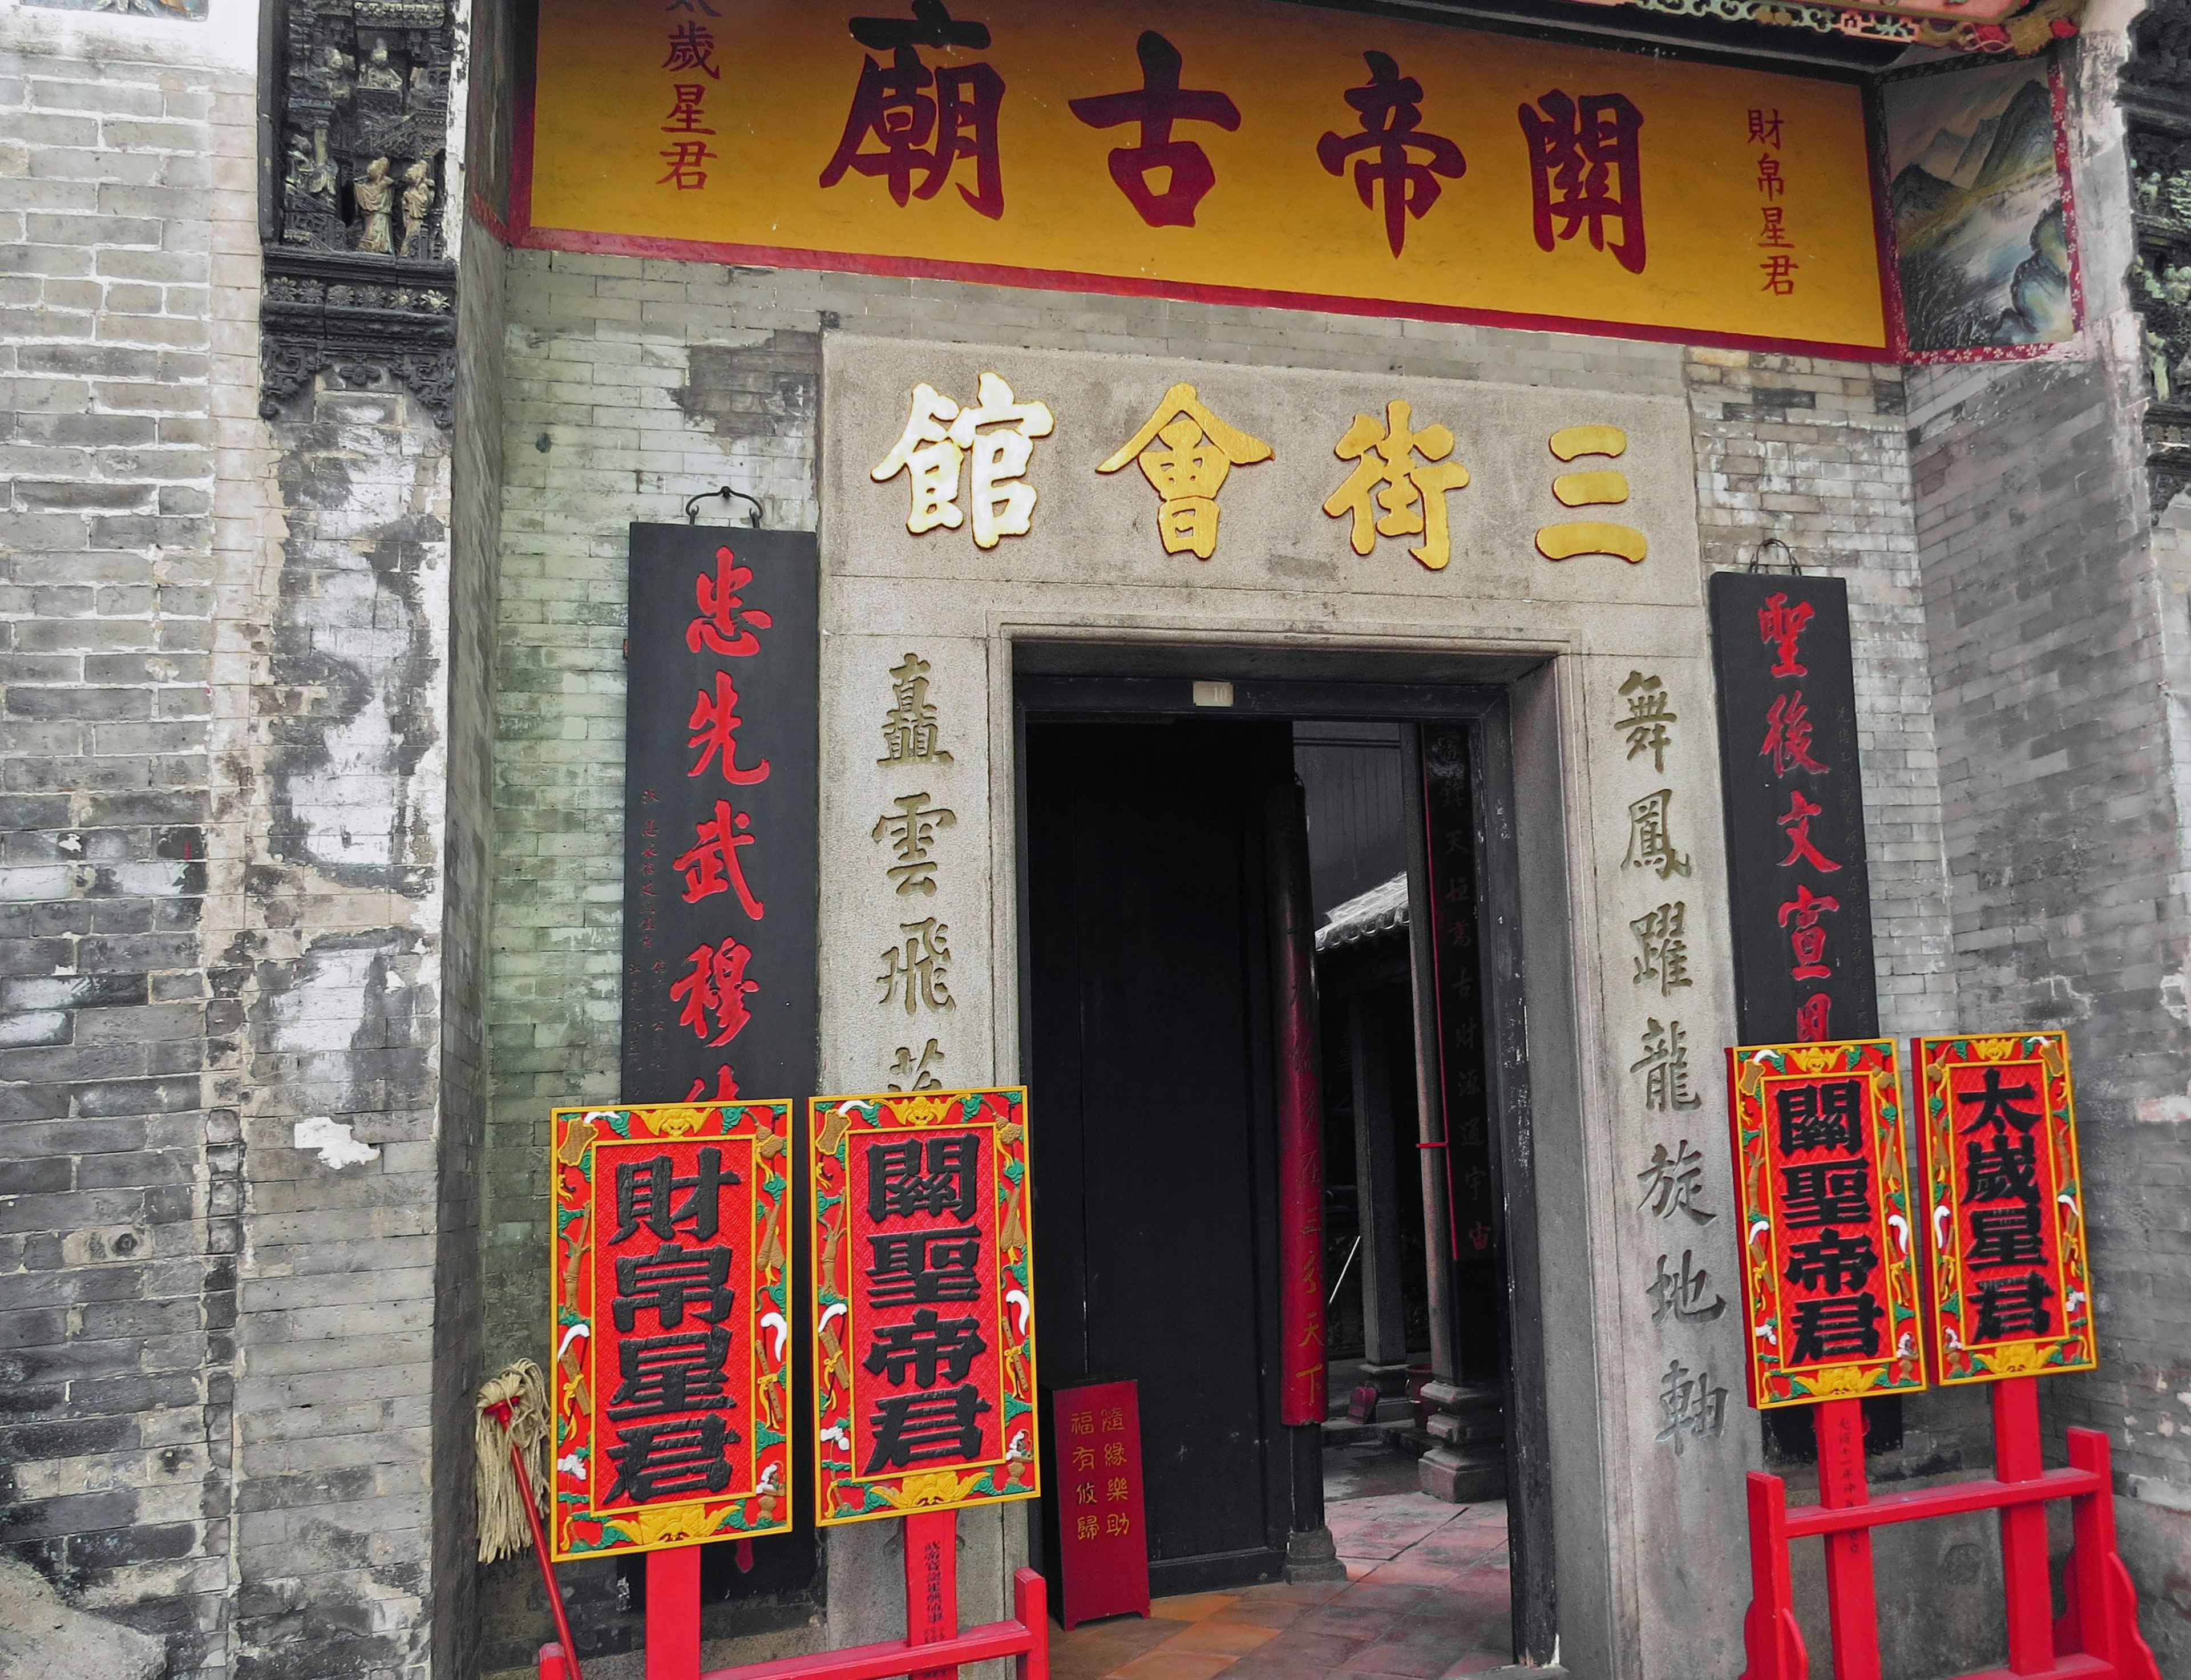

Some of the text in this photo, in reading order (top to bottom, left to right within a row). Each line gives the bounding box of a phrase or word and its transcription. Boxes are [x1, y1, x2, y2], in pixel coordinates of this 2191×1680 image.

[819, 0, 1647, 274] 關帝古廟
[1747, 108, 1800, 296] 財帛星君
[871, 371, 1647, 570] 三街會館
[1214, 686, 1227, 703] 10
[1614, 671, 1729, 1457] 舞鳳躍龍旋地軸
[602, 1146, 741, 1505] 財帛星君
[864, 1133, 991, 1475] 關聖帝君
[1775, 1079, 1883, 1365] 關聖帝君
[1958, 1067, 2053, 1343] 太歲星君
[1071, 1411, 1099, 1540] 福有攸歸
[1101, 1408, 1129, 1536] 隨緣樂助
